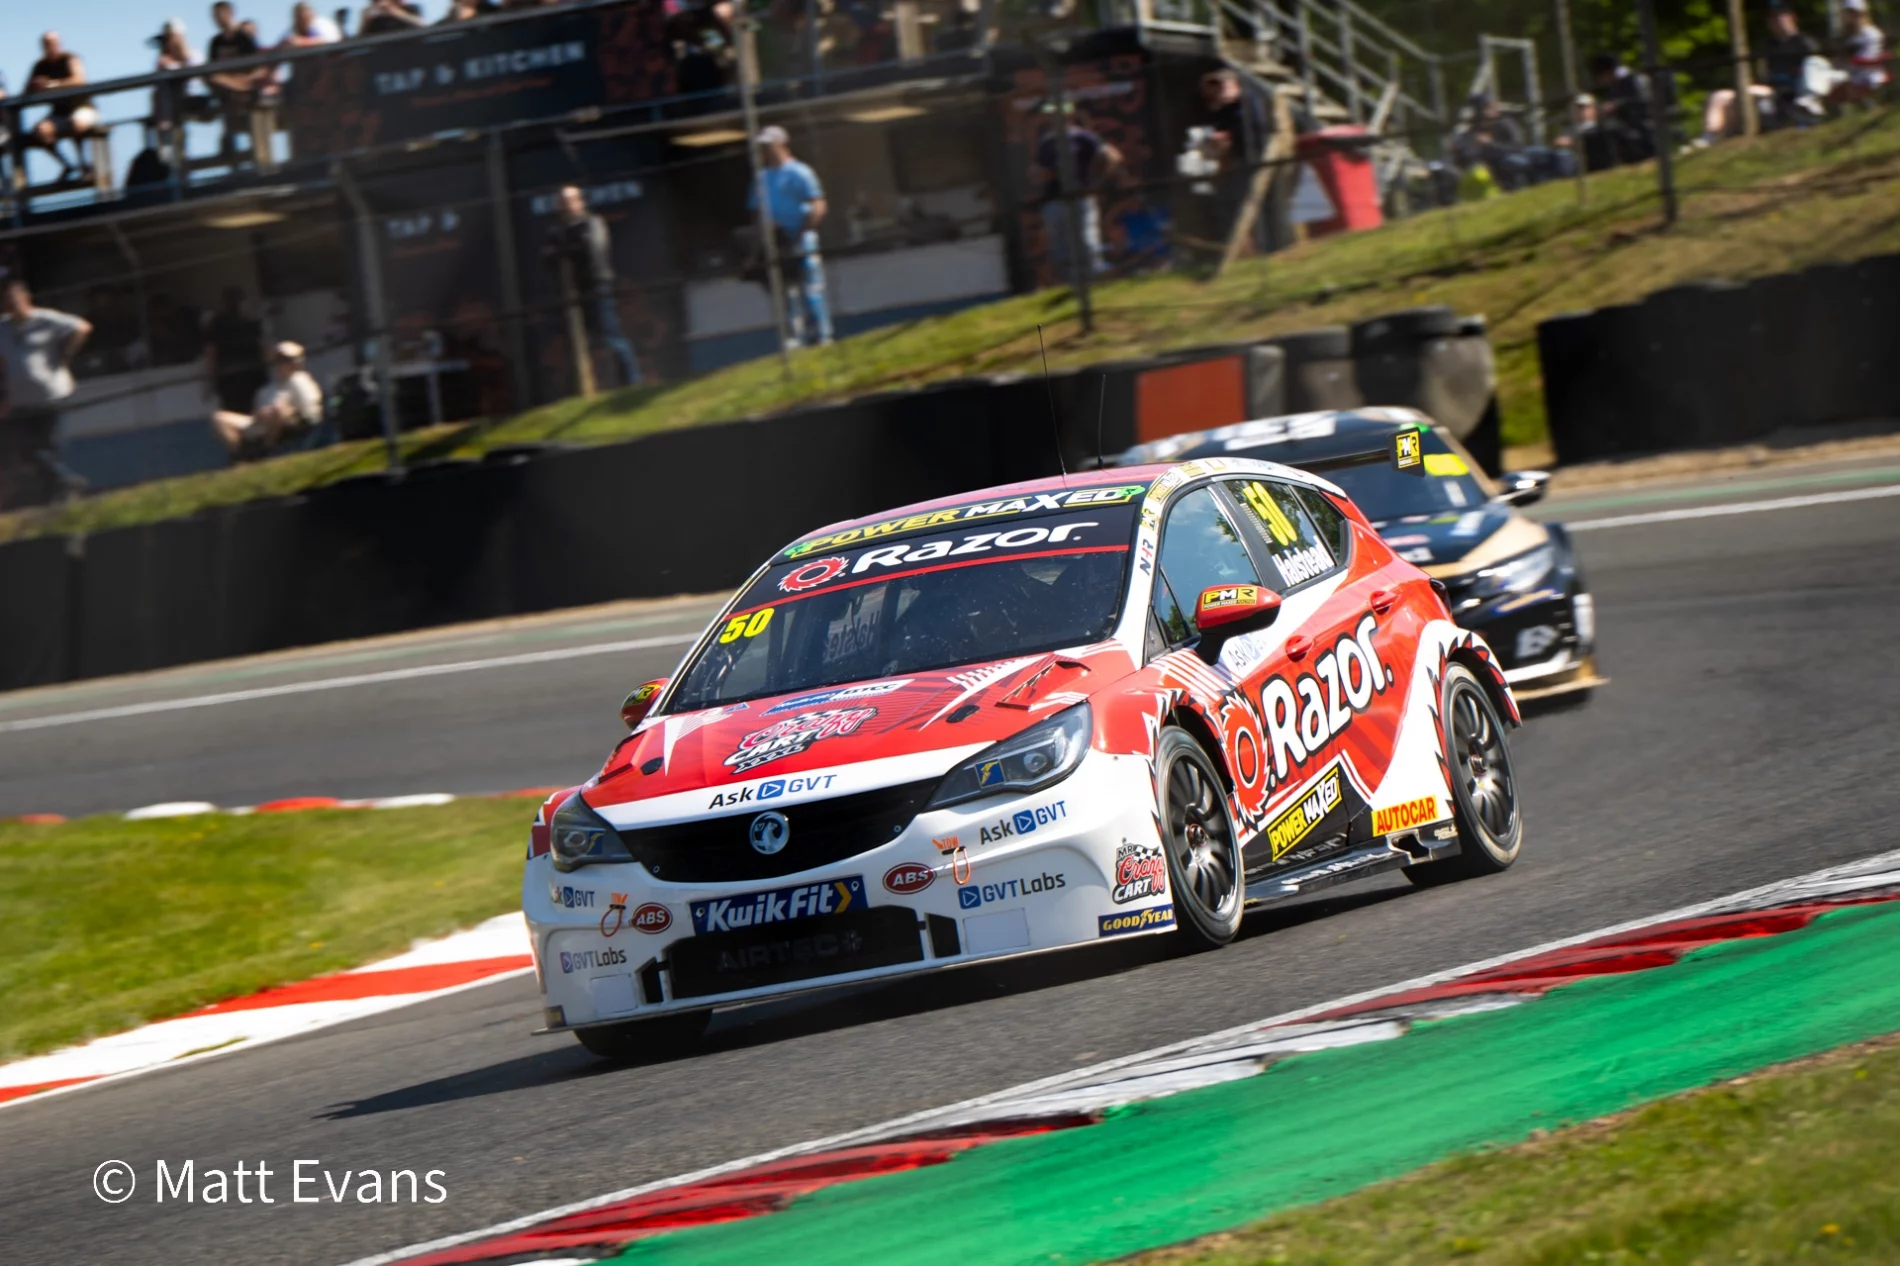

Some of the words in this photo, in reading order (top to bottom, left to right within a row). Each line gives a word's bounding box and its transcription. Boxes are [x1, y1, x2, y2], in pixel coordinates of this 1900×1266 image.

[374, 67, 425, 95] TAP
[463, 40, 585, 80] KITCHEN
[803, 509, 960, 552] POWER
[963, 487, 1124, 519] MAXED
[1242, 481, 1297, 546] 50
[1204, 588, 1255, 604] PMR
[719, 608, 775, 644] 50
[723, 730, 814, 766] CART
[708, 786, 755, 810] Ask
[788, 774, 837, 793] GVT
[980, 819, 1014, 845] Ask
[1035, 800, 1067, 825] GVT
[1270, 803, 1307, 851] POWER
[1303, 773, 1339, 826] MAXED
[1376, 799, 1437, 835] AUTOCAR
[942, 836, 959, 849] TOW
[1117, 844, 1133, 859] MR
[892, 870, 929, 887] ABS
[1113, 878, 1152, 903] CART
[574, 890, 595, 908] GVT
[636, 910, 666, 926] ABS
